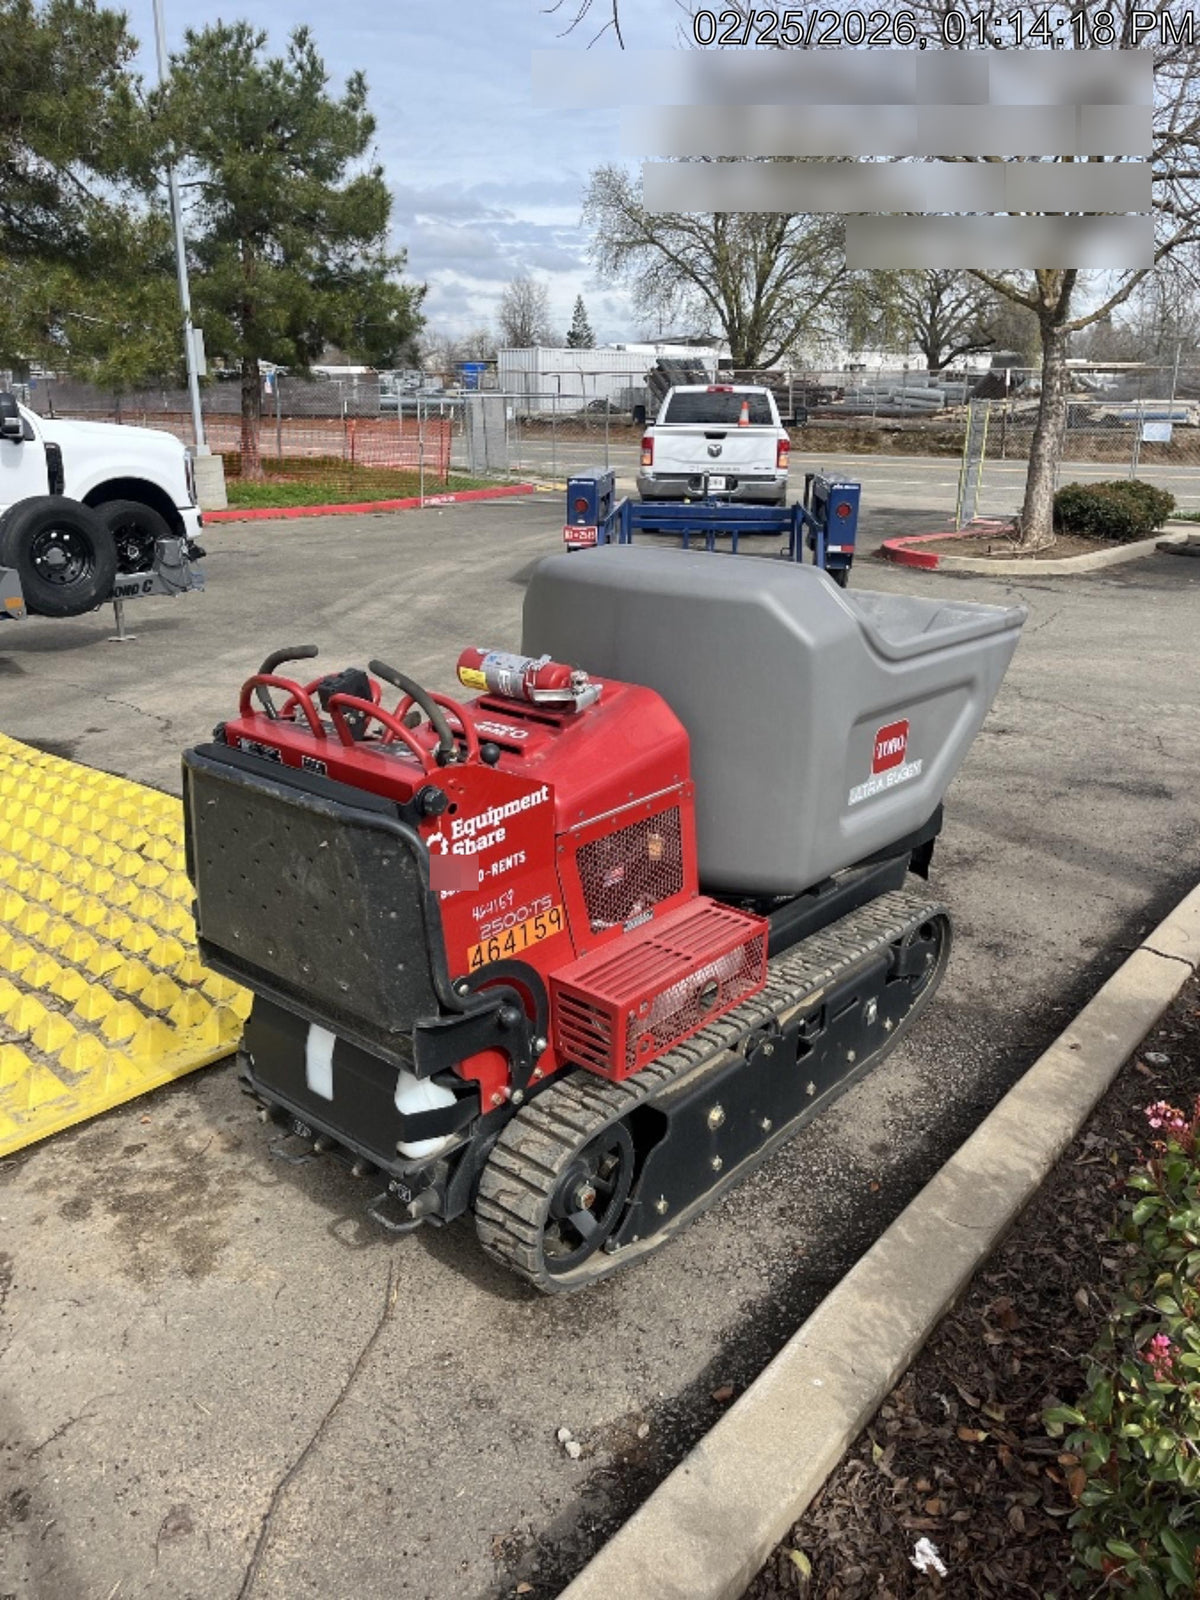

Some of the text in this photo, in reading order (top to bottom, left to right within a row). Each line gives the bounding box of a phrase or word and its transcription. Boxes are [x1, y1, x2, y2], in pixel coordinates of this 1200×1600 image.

[451, 785, 550, 840] Equipment
[452, 827, 506, 856] Share
[471, 908, 561, 968] 464159
